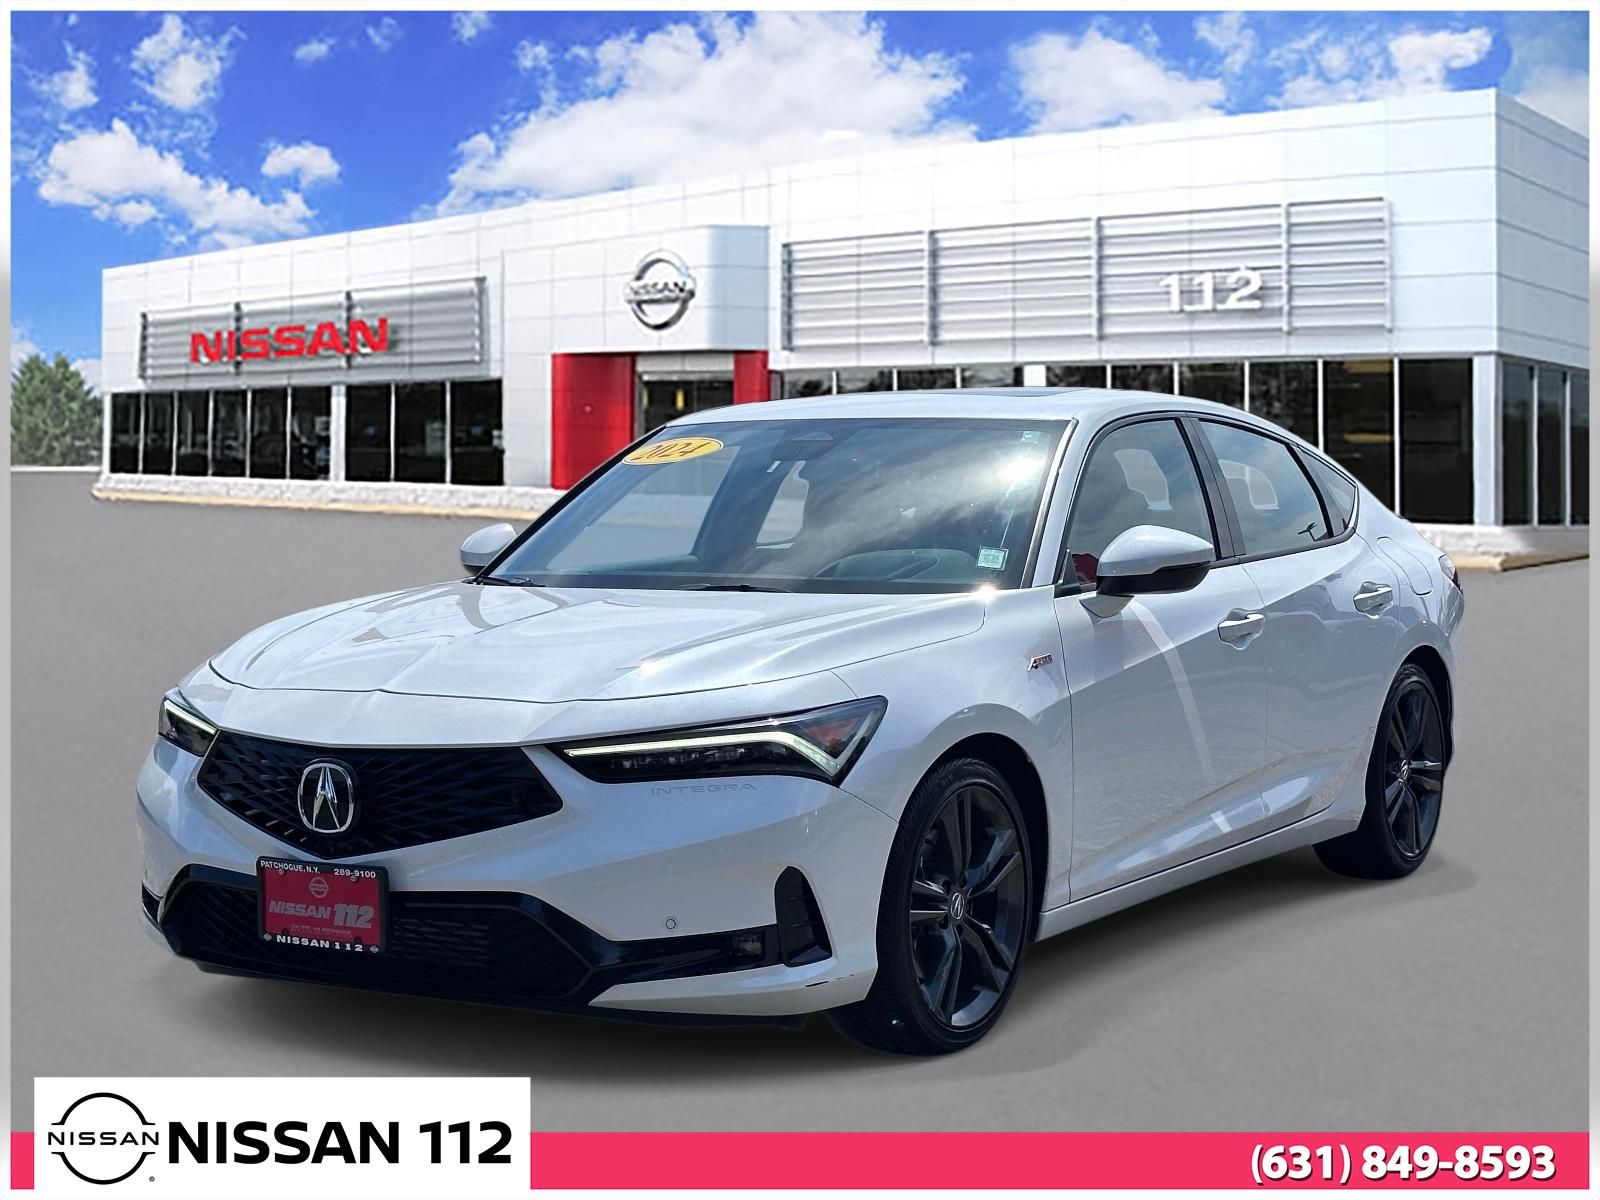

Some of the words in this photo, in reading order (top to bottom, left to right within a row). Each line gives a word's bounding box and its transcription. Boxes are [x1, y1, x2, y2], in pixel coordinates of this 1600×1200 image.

[1159, 270, 1262, 312] 112
[190, 317, 389, 363] NISSAN
[630, 441, 713, 461] 2024
[650, 783, 757, 796] INTEGRA
[269, 900, 331, 919] NISSAN
[334, 903, 375, 928] 112
[276, 935, 330, 948] NISSAN
